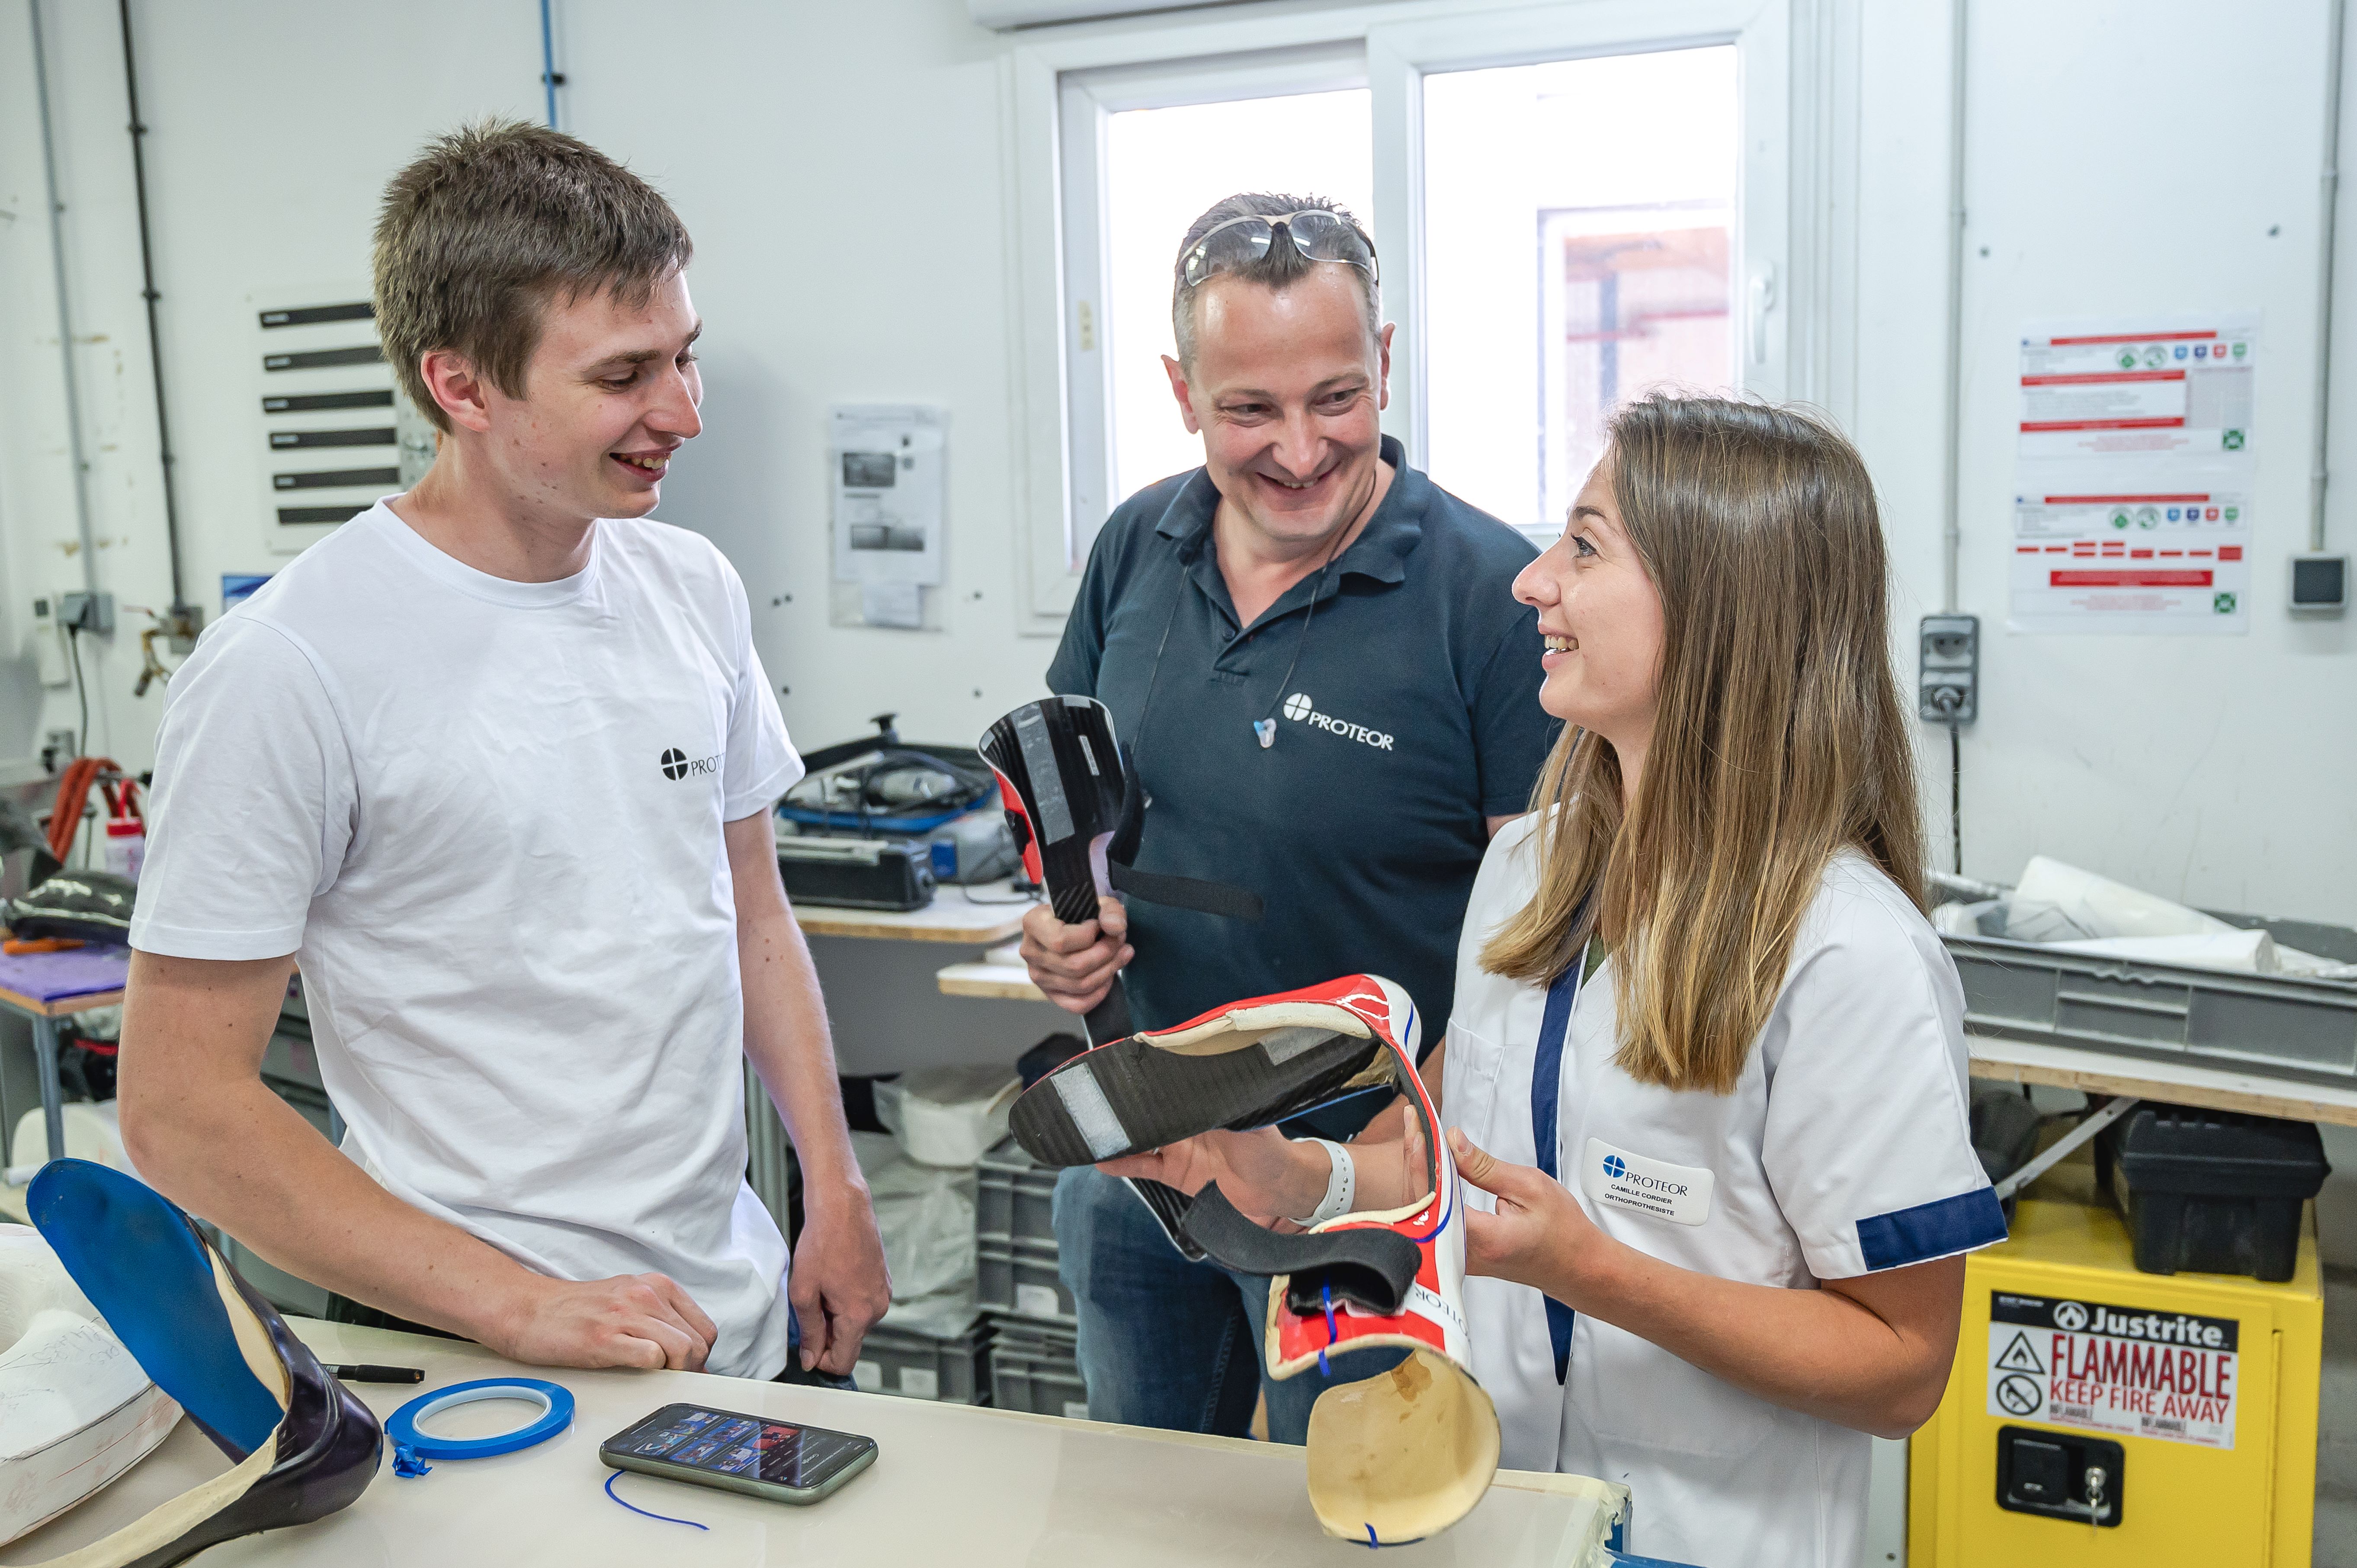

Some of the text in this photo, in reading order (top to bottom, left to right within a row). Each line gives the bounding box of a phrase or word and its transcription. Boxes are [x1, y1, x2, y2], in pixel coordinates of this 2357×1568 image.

[1308, 712, 1394, 750] PROTEOR
[1611, 1184, 1672, 1204] CAMILLE CORDIER
[1626, 1172, 1687, 1196] PROTEOR
[1605, 1193, 1675, 1216] ORTHOPROTHESISTE
[2091, 1307, 2223, 1348] Justrite
[2052, 1334, 2231, 1400] FLAMMABLE
[2050, 1380, 2104, 1405] KEEP
[2110, 1386, 2157, 1415] FIRE
[2163, 1395, 2229, 1424] AWAY
